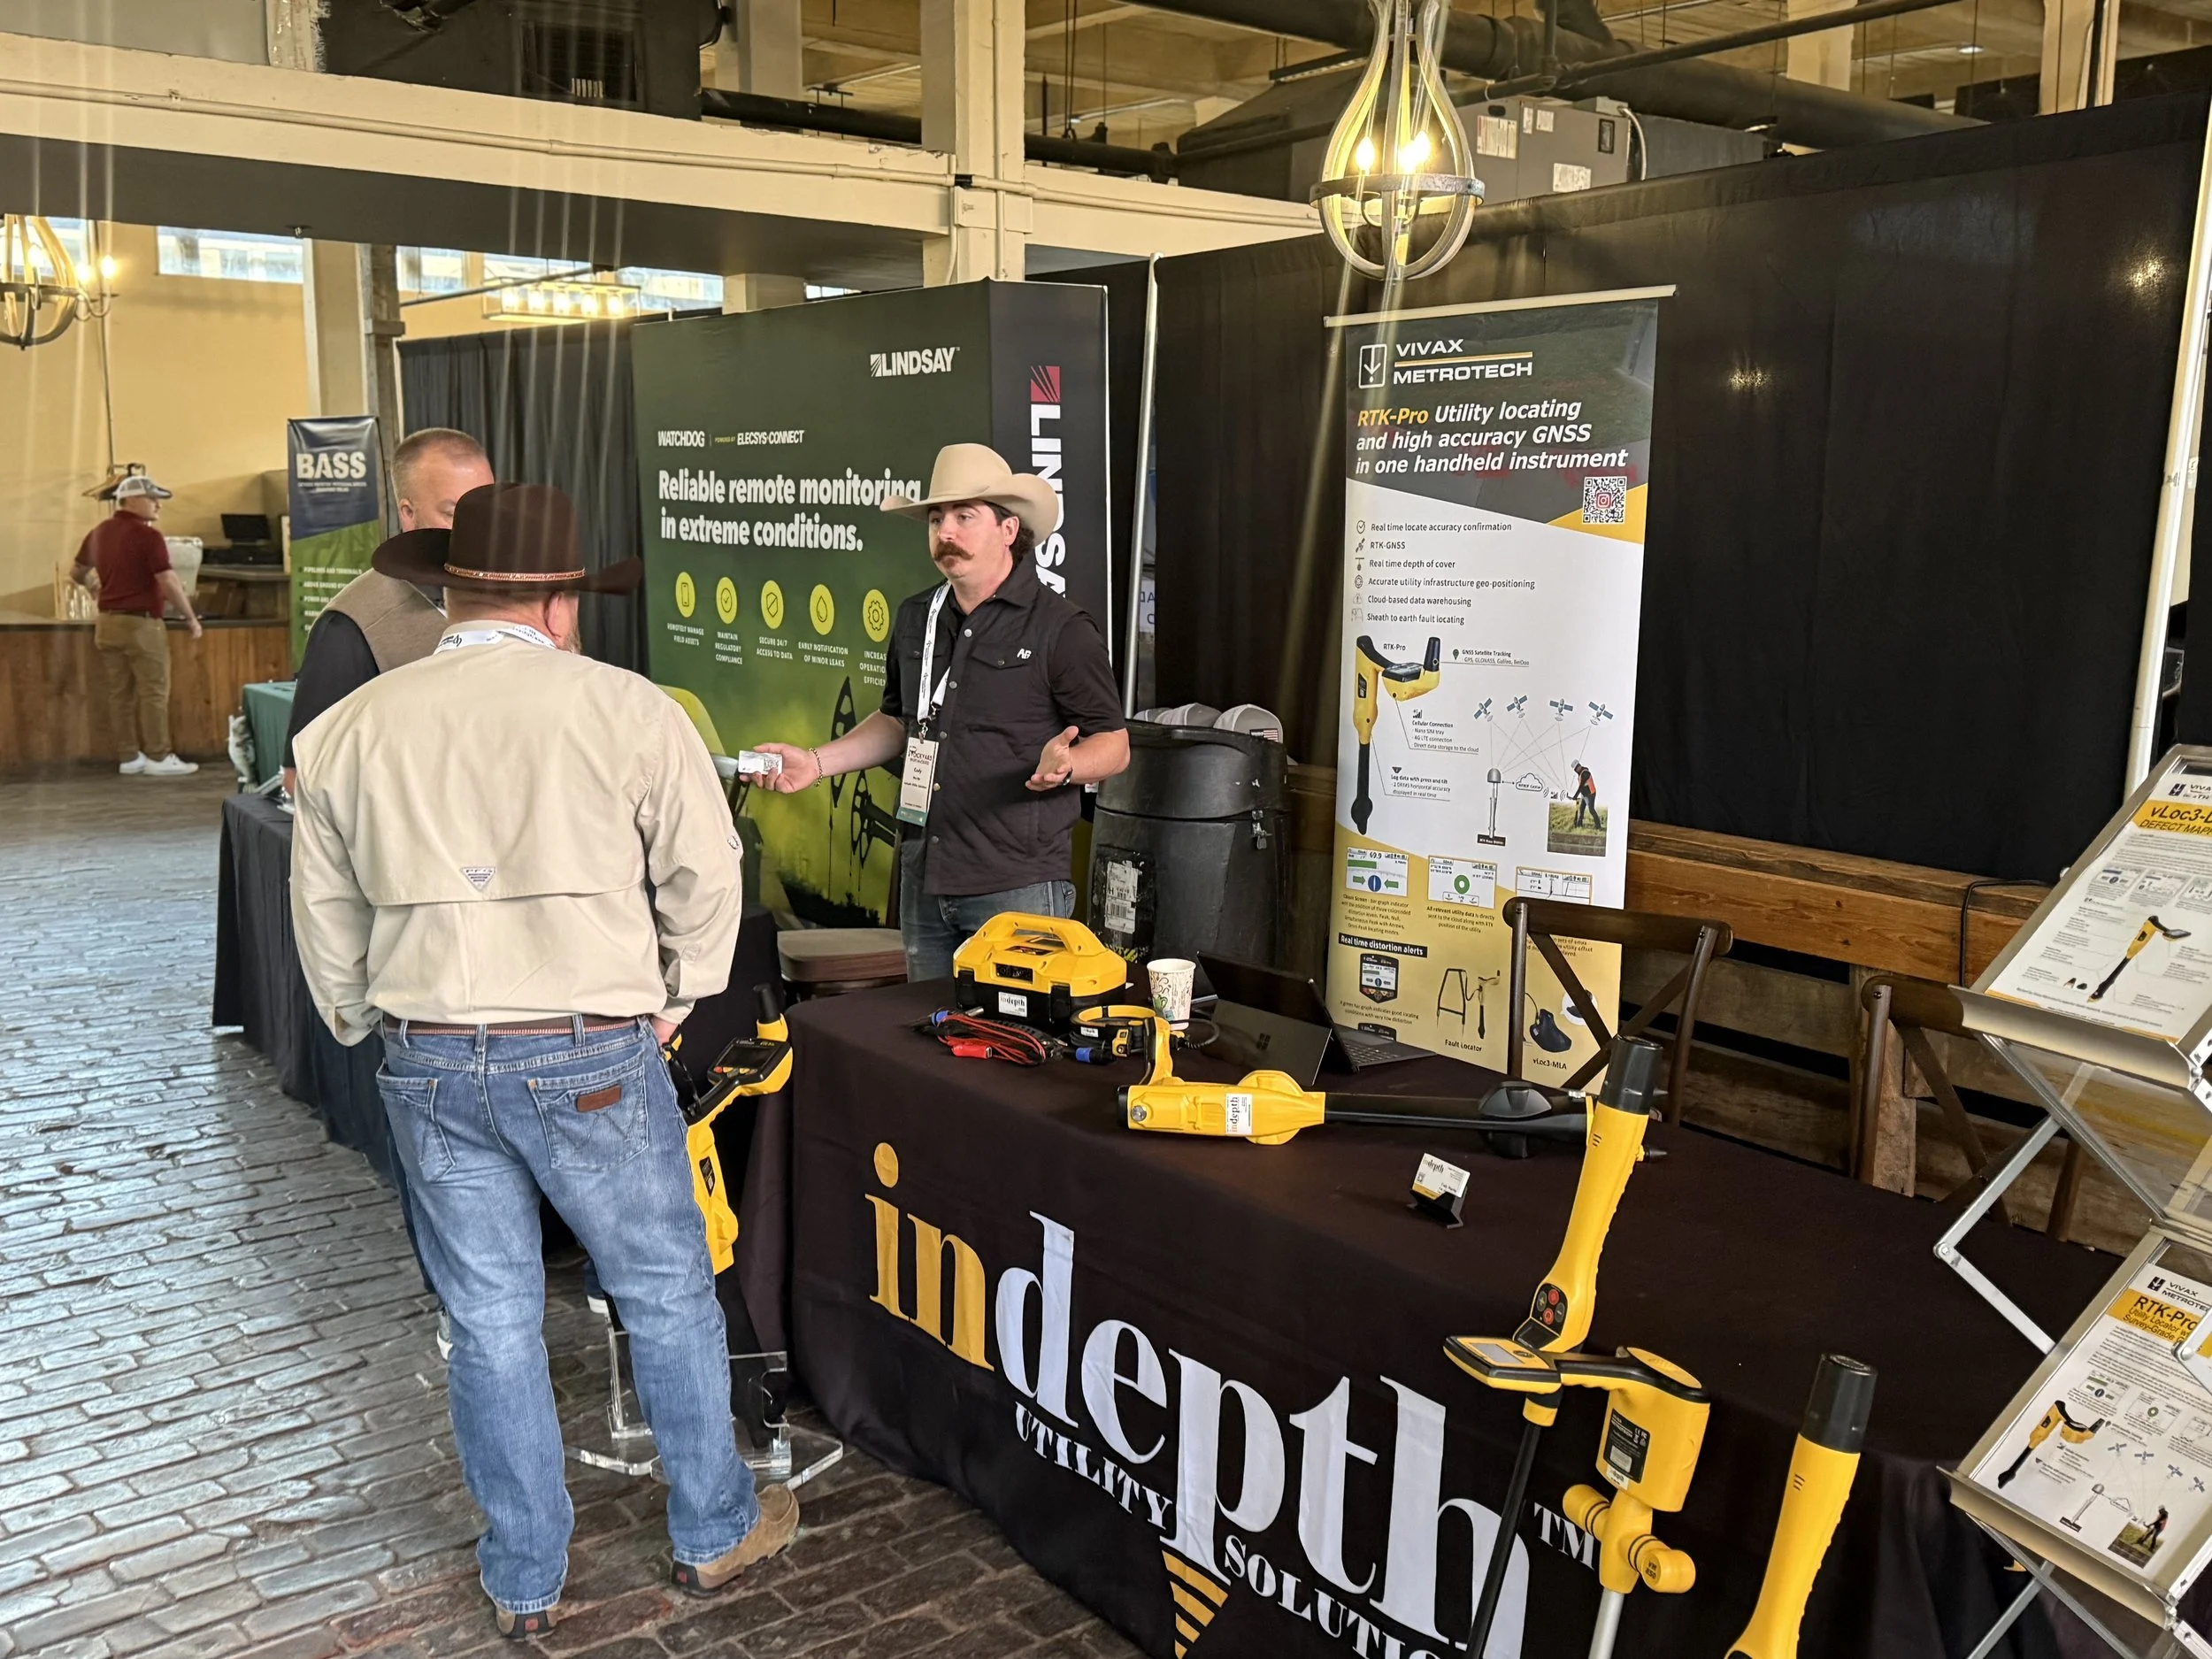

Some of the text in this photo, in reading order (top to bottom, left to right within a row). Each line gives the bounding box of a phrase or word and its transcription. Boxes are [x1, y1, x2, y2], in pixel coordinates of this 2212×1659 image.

[1396, 339, 1463, 357] VIVAX
[882, 347, 956, 376] LINDSAY
[1394, 362, 1532, 385] METROTECH
[1357, 399, 1581, 426] RTK-Pro Utility locating
[657, 430, 705, 448] WATCHDOG
[1356, 424, 1592, 452] and high accuracy GNSS
[296, 451, 366, 479] BASS
[1356, 449, 1628, 474] in one handheld instrument
[659, 468, 726, 503] Reliable
[729, 474, 795, 504] remote
[661, 506, 864, 551] in extreme conditions.
[1429, 524, 1462, 533] accuracy
[1463, 522, 1512, 531] confirmation
[1403, 560, 1425, 569] depth
[1426, 559, 1433, 568] of
[1400, 579, 1422, 588] utility
[1476, 580, 1535, 589] geo-positioning
[1368, 595, 1408, 604] Cloud-based
[1427, 597, 1471, 607] warehousing
[1418, 614, 1435, 623] fault
[1436, 615, 1464, 626] locating
[759, 637, 776, 646] SECURE
[798, 641, 849, 655] EARLY NOTIFICATION
[716, 654, 742, 664] COMPLIANCE
[757, 649, 772, 657] ACCESS
[812, 657, 828, 665] MINOR
[2139, 819, 2185, 831] DEFECT
[1354, 937, 1368, 947] time
[1369, 941, 1402, 953] distortion
[1403, 946, 1424, 956] alerts
[1445, 1039, 1482, 1052] Fault Locator
[1230, 1097, 1240, 1132] indepth
[2170, 1281, 2199, 1296] VIVAX
[2133, 1295, 2198, 1331] RTK-Pro
[2124, 1314, 2175, 1340] Survey-Grade
[2150, 1316, 2178, 1333] Locator
[864, 1142, 1530, 1659] indepth
[1016, 1402, 1173, 1530] UTILITY
[1225, 1534, 1441, 1659] SOLUTI
